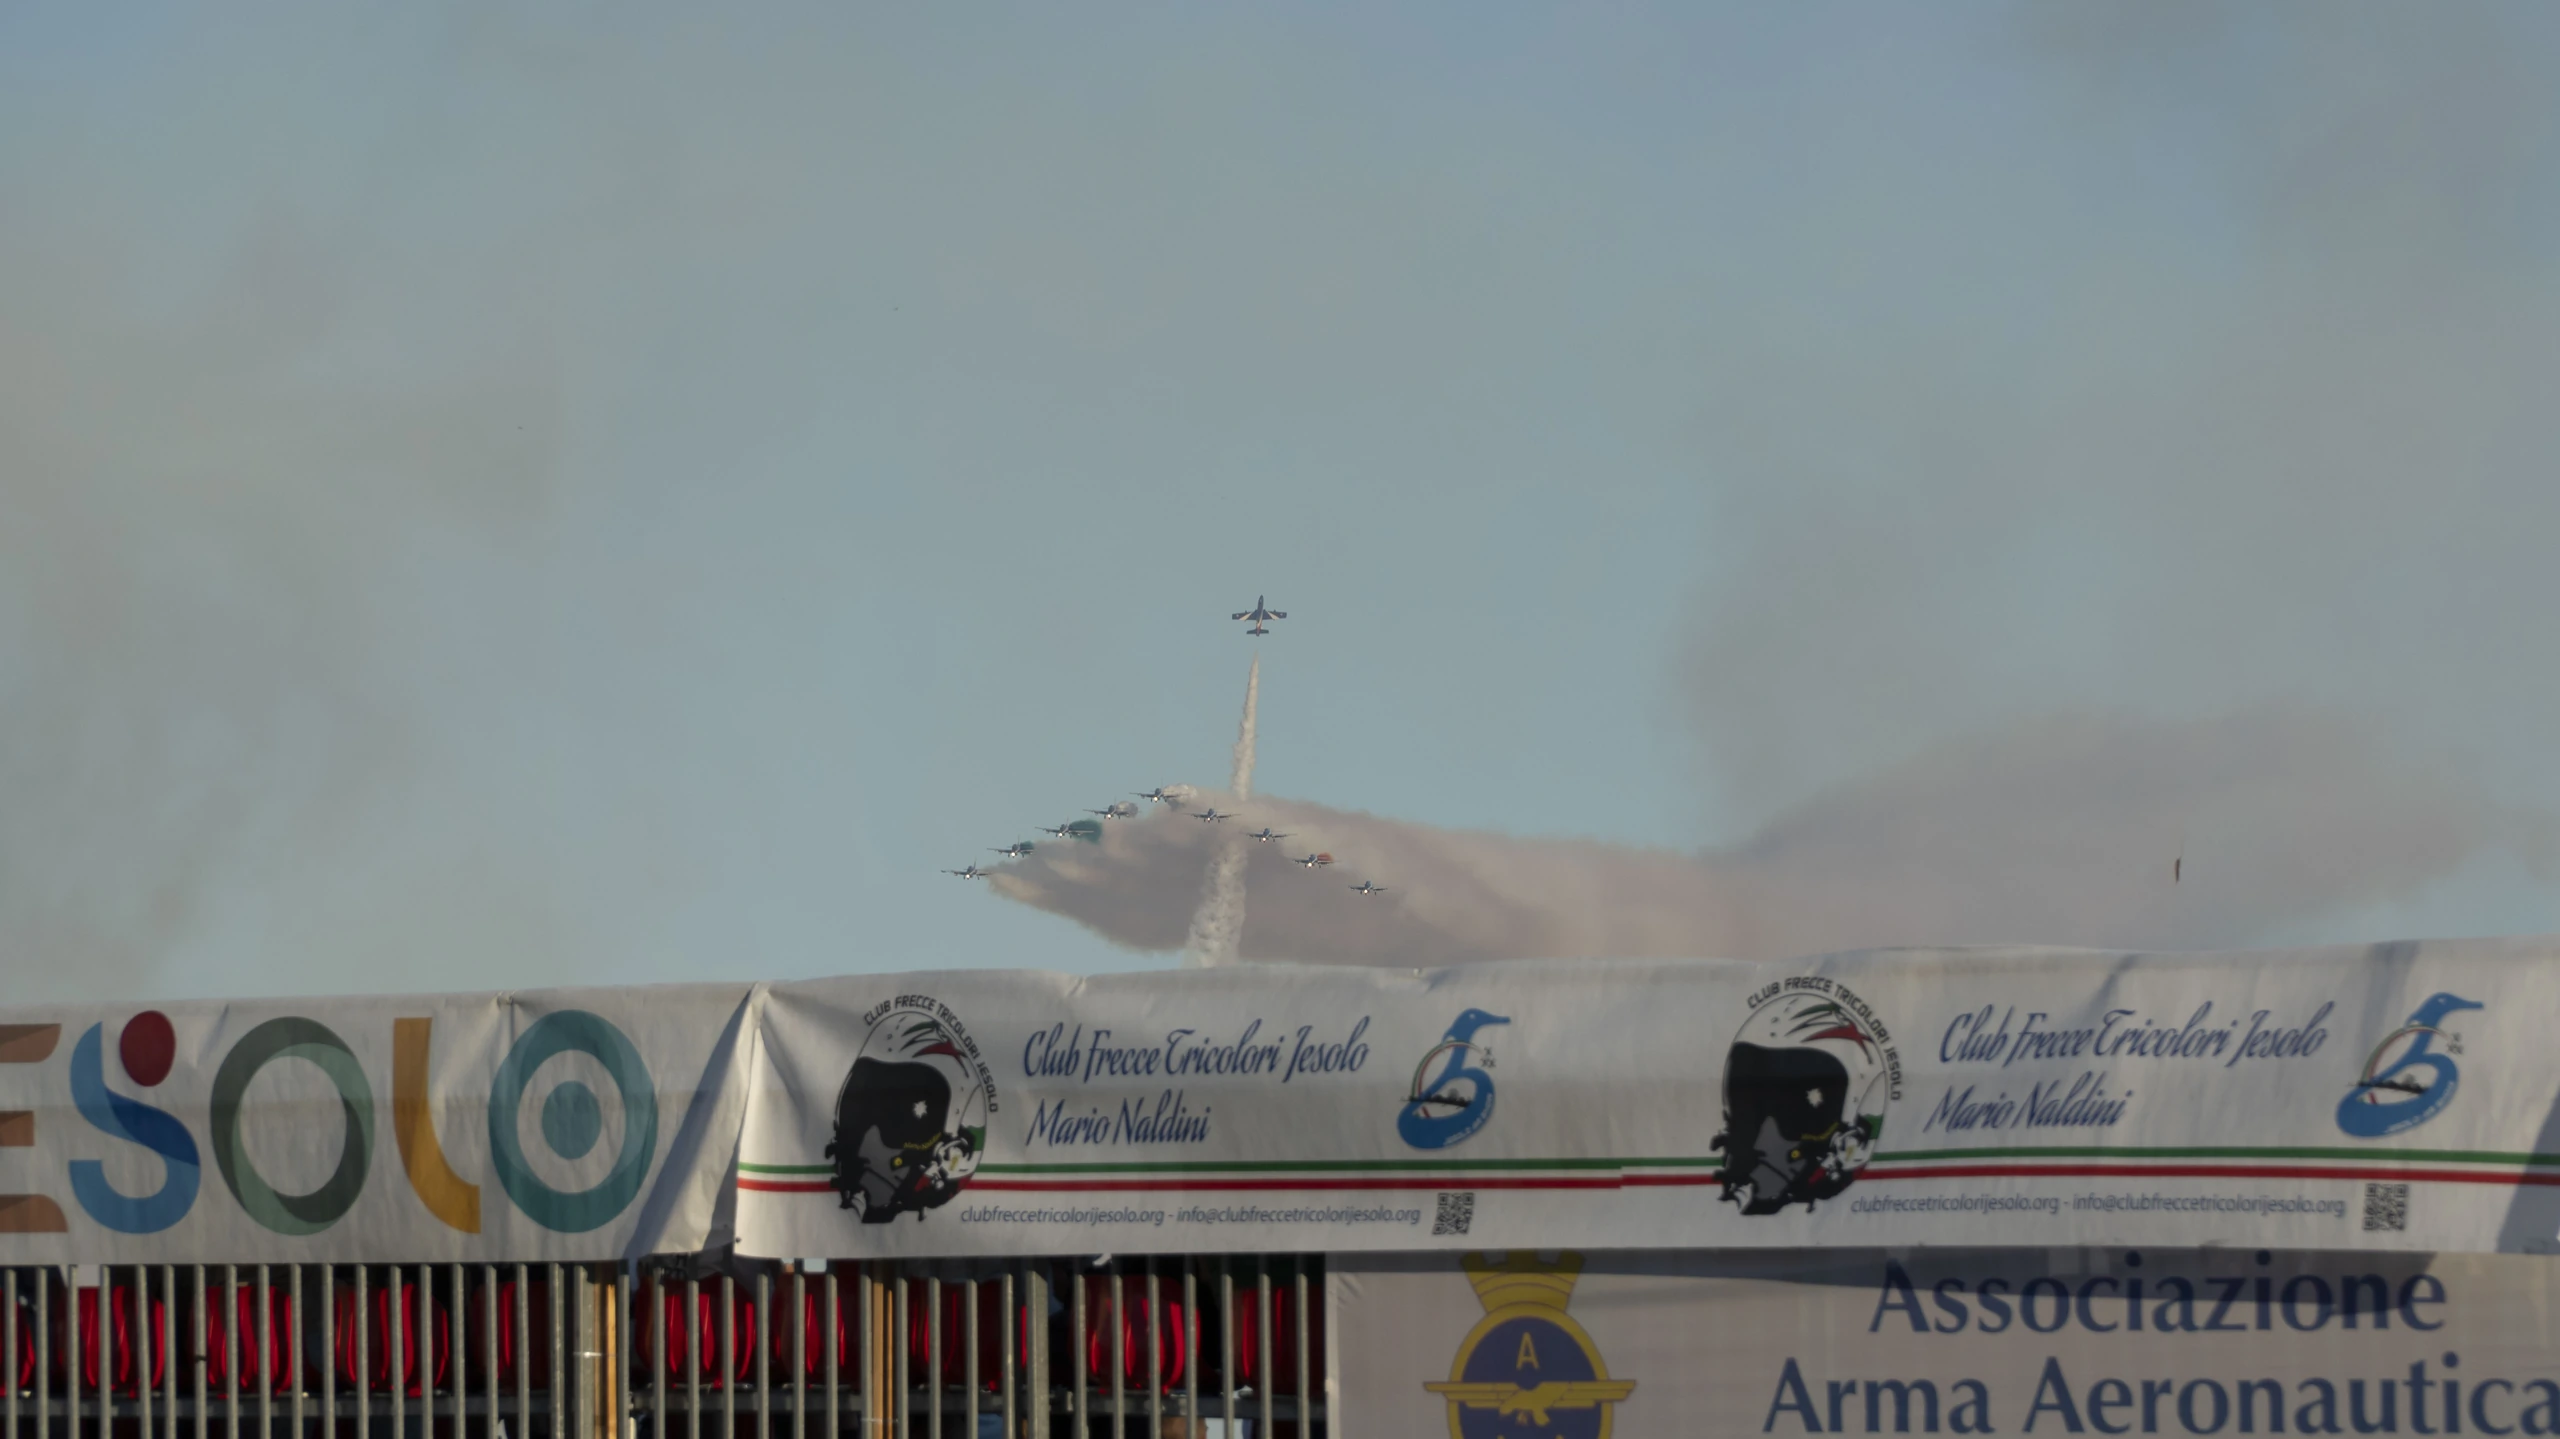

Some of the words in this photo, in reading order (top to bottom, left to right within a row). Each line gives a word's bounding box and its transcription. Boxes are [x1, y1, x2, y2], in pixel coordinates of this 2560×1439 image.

[864, 1000, 891, 1026] CLUB
[895, 995, 936, 1011] FRECCE
[936, 1003, 980, 1059] TRICOLORI
[977, 1061, 998, 1113] JESOLO
[1024, 1022, 1082, 1077] Club
[1083, 1029, 1160, 1083] Frecce
[1166, 1018, 1285, 1075] Tricolori
[1282, 1015, 1370, 1083] Jesolo
[1747, 982, 1780, 1009] CLUB
[1784, 976, 1833, 993] FRECCE
[1834, 984, 1891, 1044] TRICOLORI
[1883, 1047, 1903, 1100] JESOLO
[1939, 1003, 2013, 1063] Club
[2003, 1012, 2093, 1067] Frecce
[2094, 1001, 2237, 1058] Tricolori
[2225, 1001, 2335, 1067] Jesolo
[1025, 1097, 1110, 1147] Mario
[1113, 1088, 1211, 1146] Naldini
[1923, 1084, 2014, 1133] Mario
[2011, 1070, 2134, 1129] Naldini
[960, 1205, 1165, 1226] clubfreccetricolorijesolo.org
[1176, 1205, 1421, 1225] info@clubfreccetricolorijesolo.org
[1850, 1194, 2059, 1215] clubfreccetricolorijesolo.org
[2072, 1192, 2346, 1217] info@clubfreccetricolorijesolo.org
[1868, 1251, 2446, 1333] Associazione
[1516, 1331, 1540, 1371] A
[1762, 1356, 1994, 1434] Arma
[2022, 1351, 2560, 1437] Aeronautica
